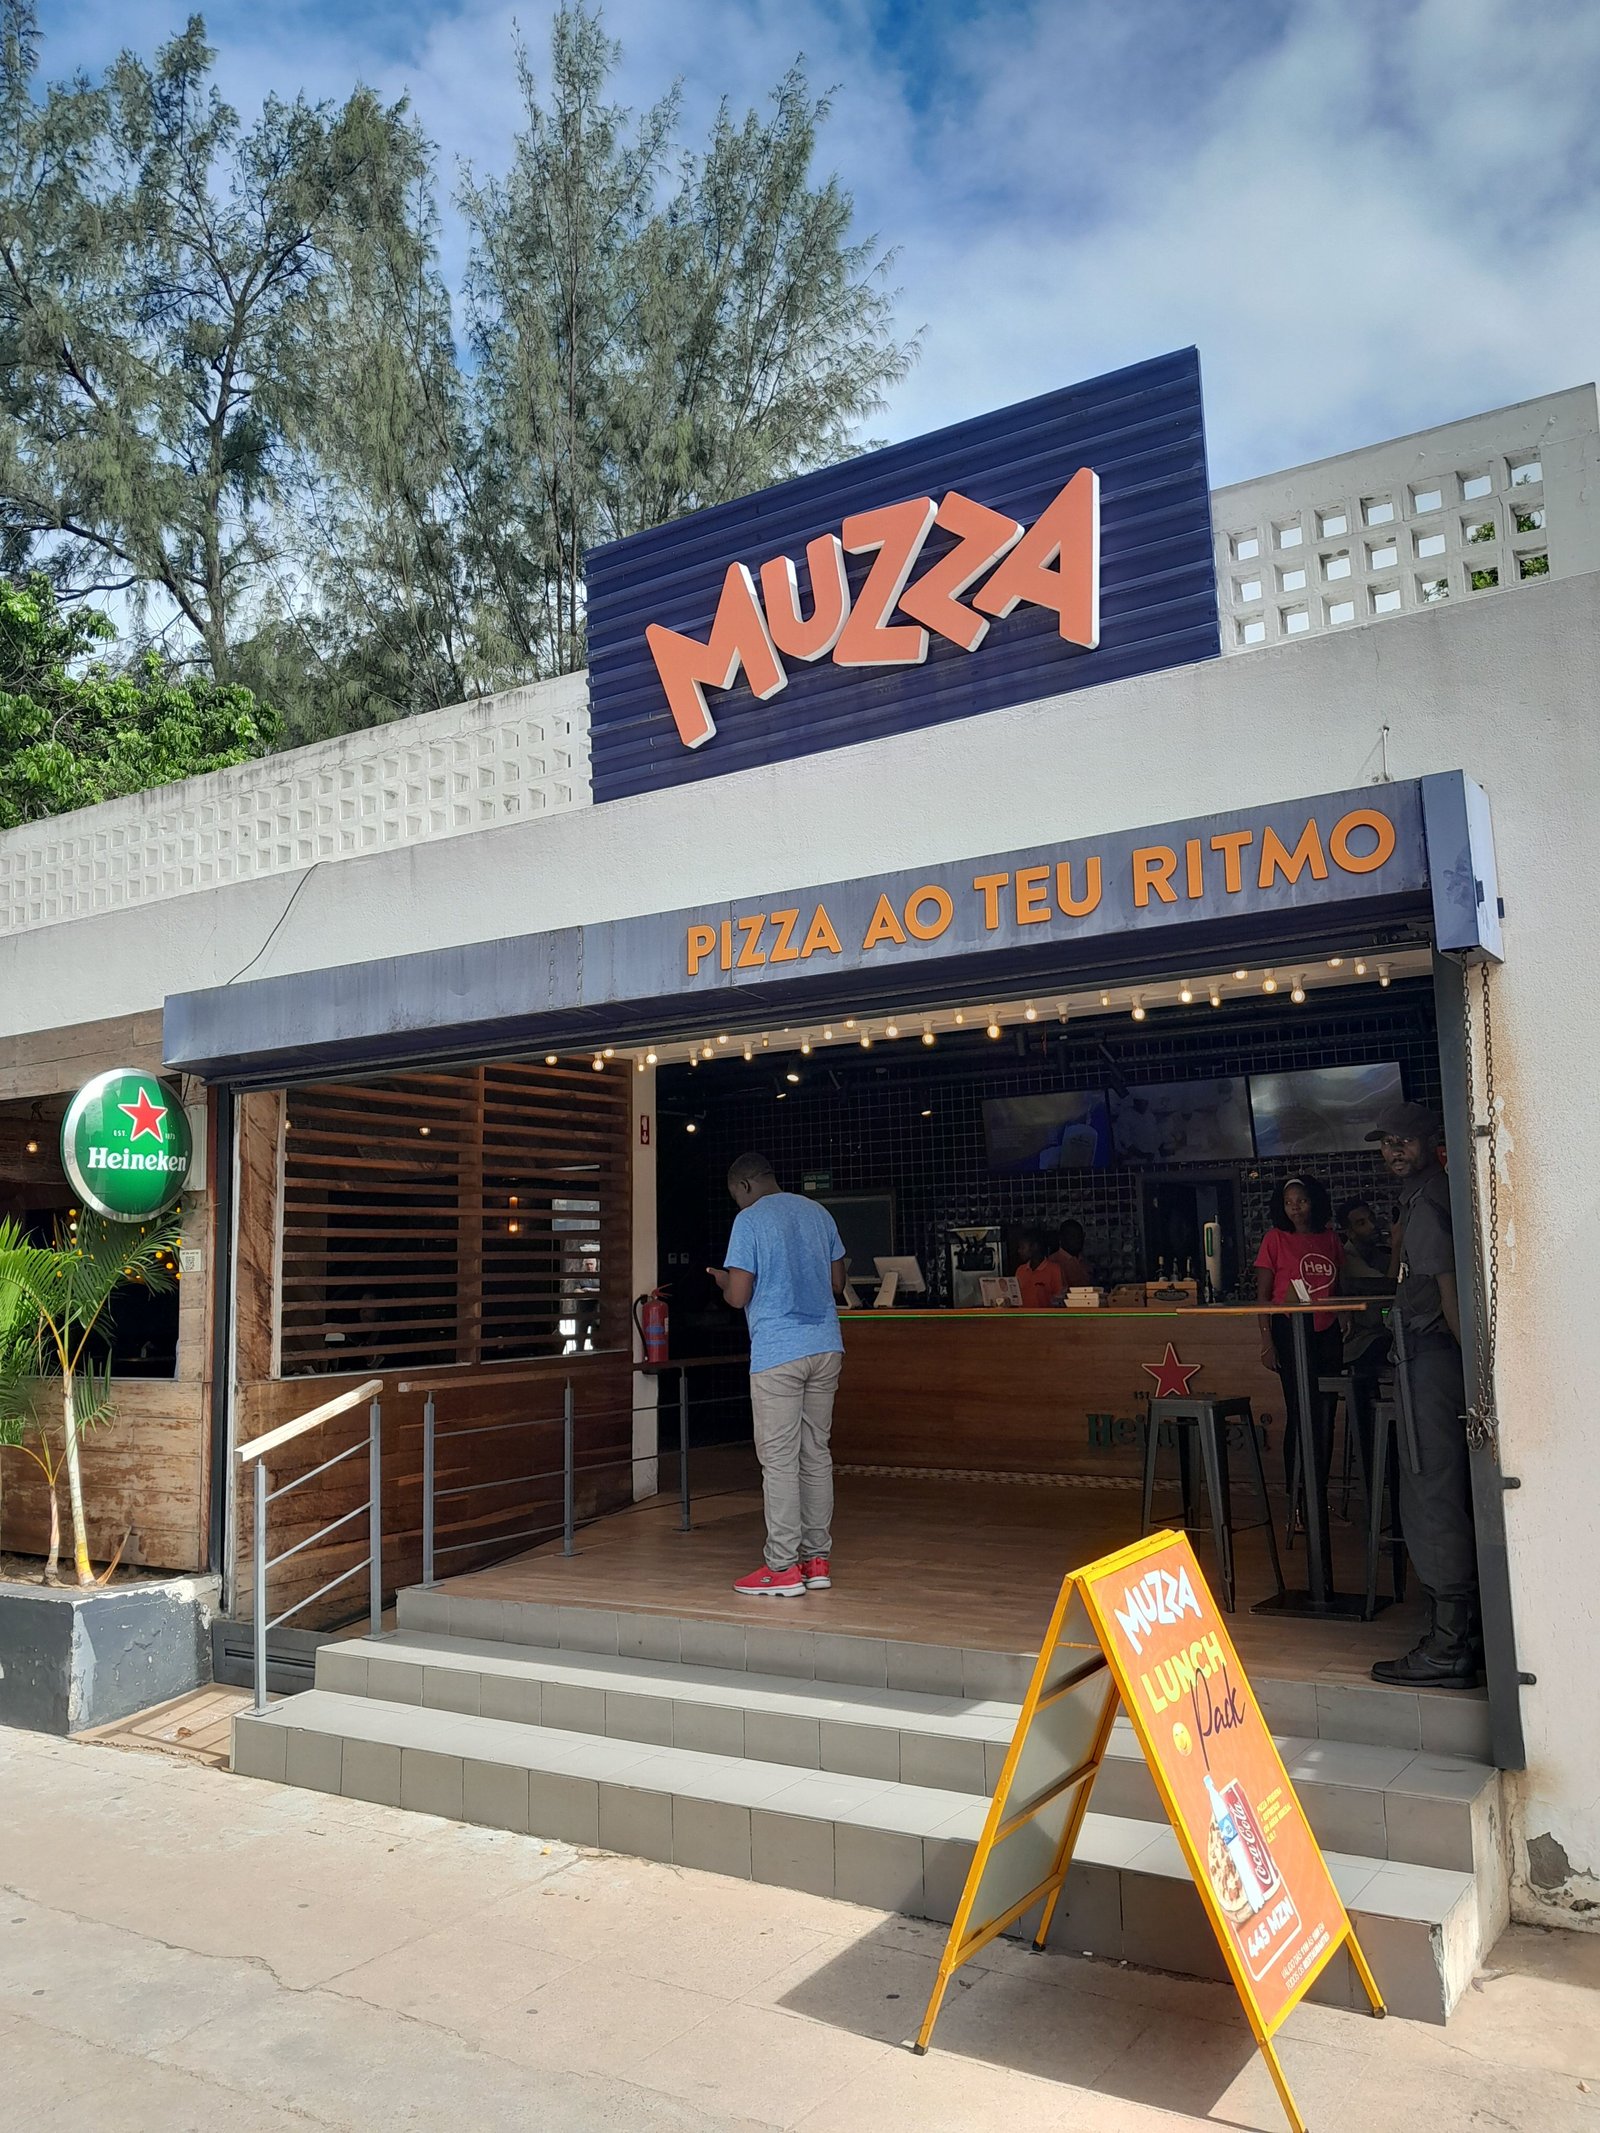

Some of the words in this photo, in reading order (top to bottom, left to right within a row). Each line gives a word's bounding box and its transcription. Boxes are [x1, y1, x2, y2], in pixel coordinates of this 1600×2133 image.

[645, 467, 1101, 750] MUZZA
[686, 902, 842, 974] PIZZA
[863, 886, 953, 948] AO
[974, 857, 1101, 930] TEU
[1133, 809, 1395, 907] RITMO
[87, 1147, 187, 1173] Heineken
[1303, 1260, 1333, 1277] Hey
[1113, 1565, 1203, 1656] MUZZA
[1140, 1630, 1228, 1715] LUNCH
[1189, 1662, 1246, 1772] Pack
[1247, 1922, 1271, 1958] 445
[1266, 1895, 1294, 1937] MZN
